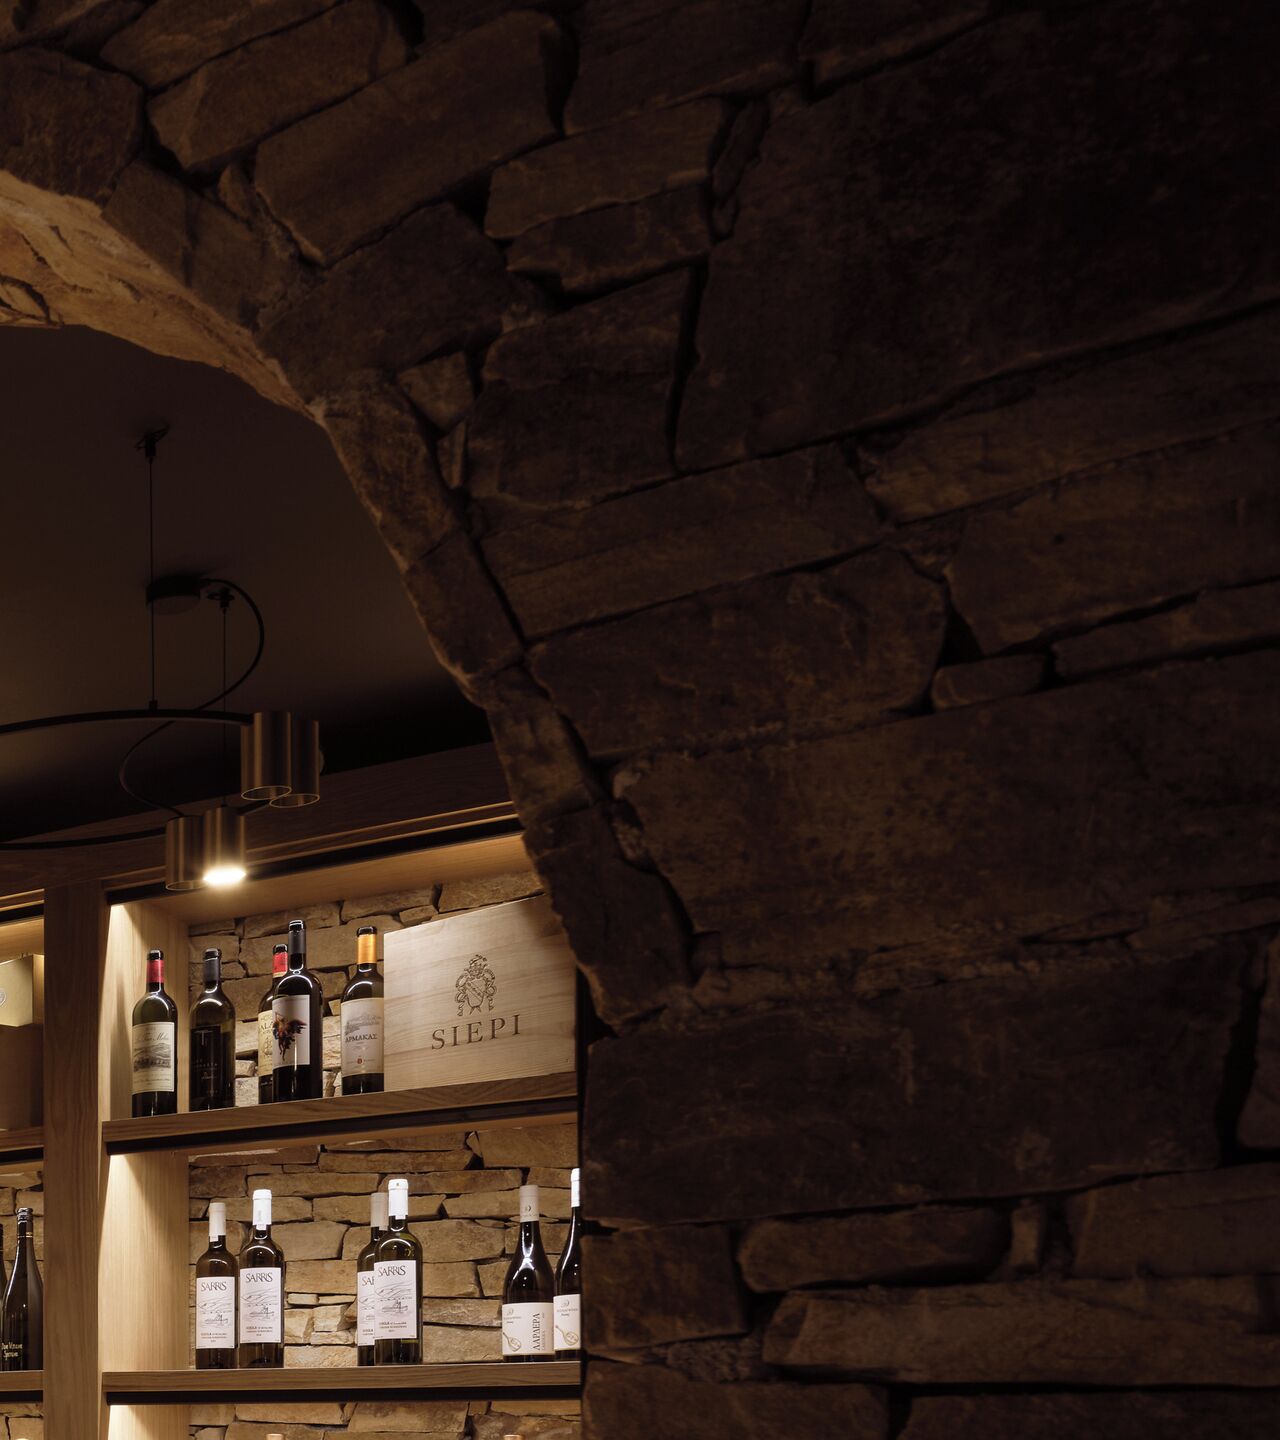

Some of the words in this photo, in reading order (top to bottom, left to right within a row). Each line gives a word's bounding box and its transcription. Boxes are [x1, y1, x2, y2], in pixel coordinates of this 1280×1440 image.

[431, 1013, 521, 1050] SIEPI
[246, 1271, 273, 1284] SARRIS
[378, 1265, 406, 1278] SARRIS
